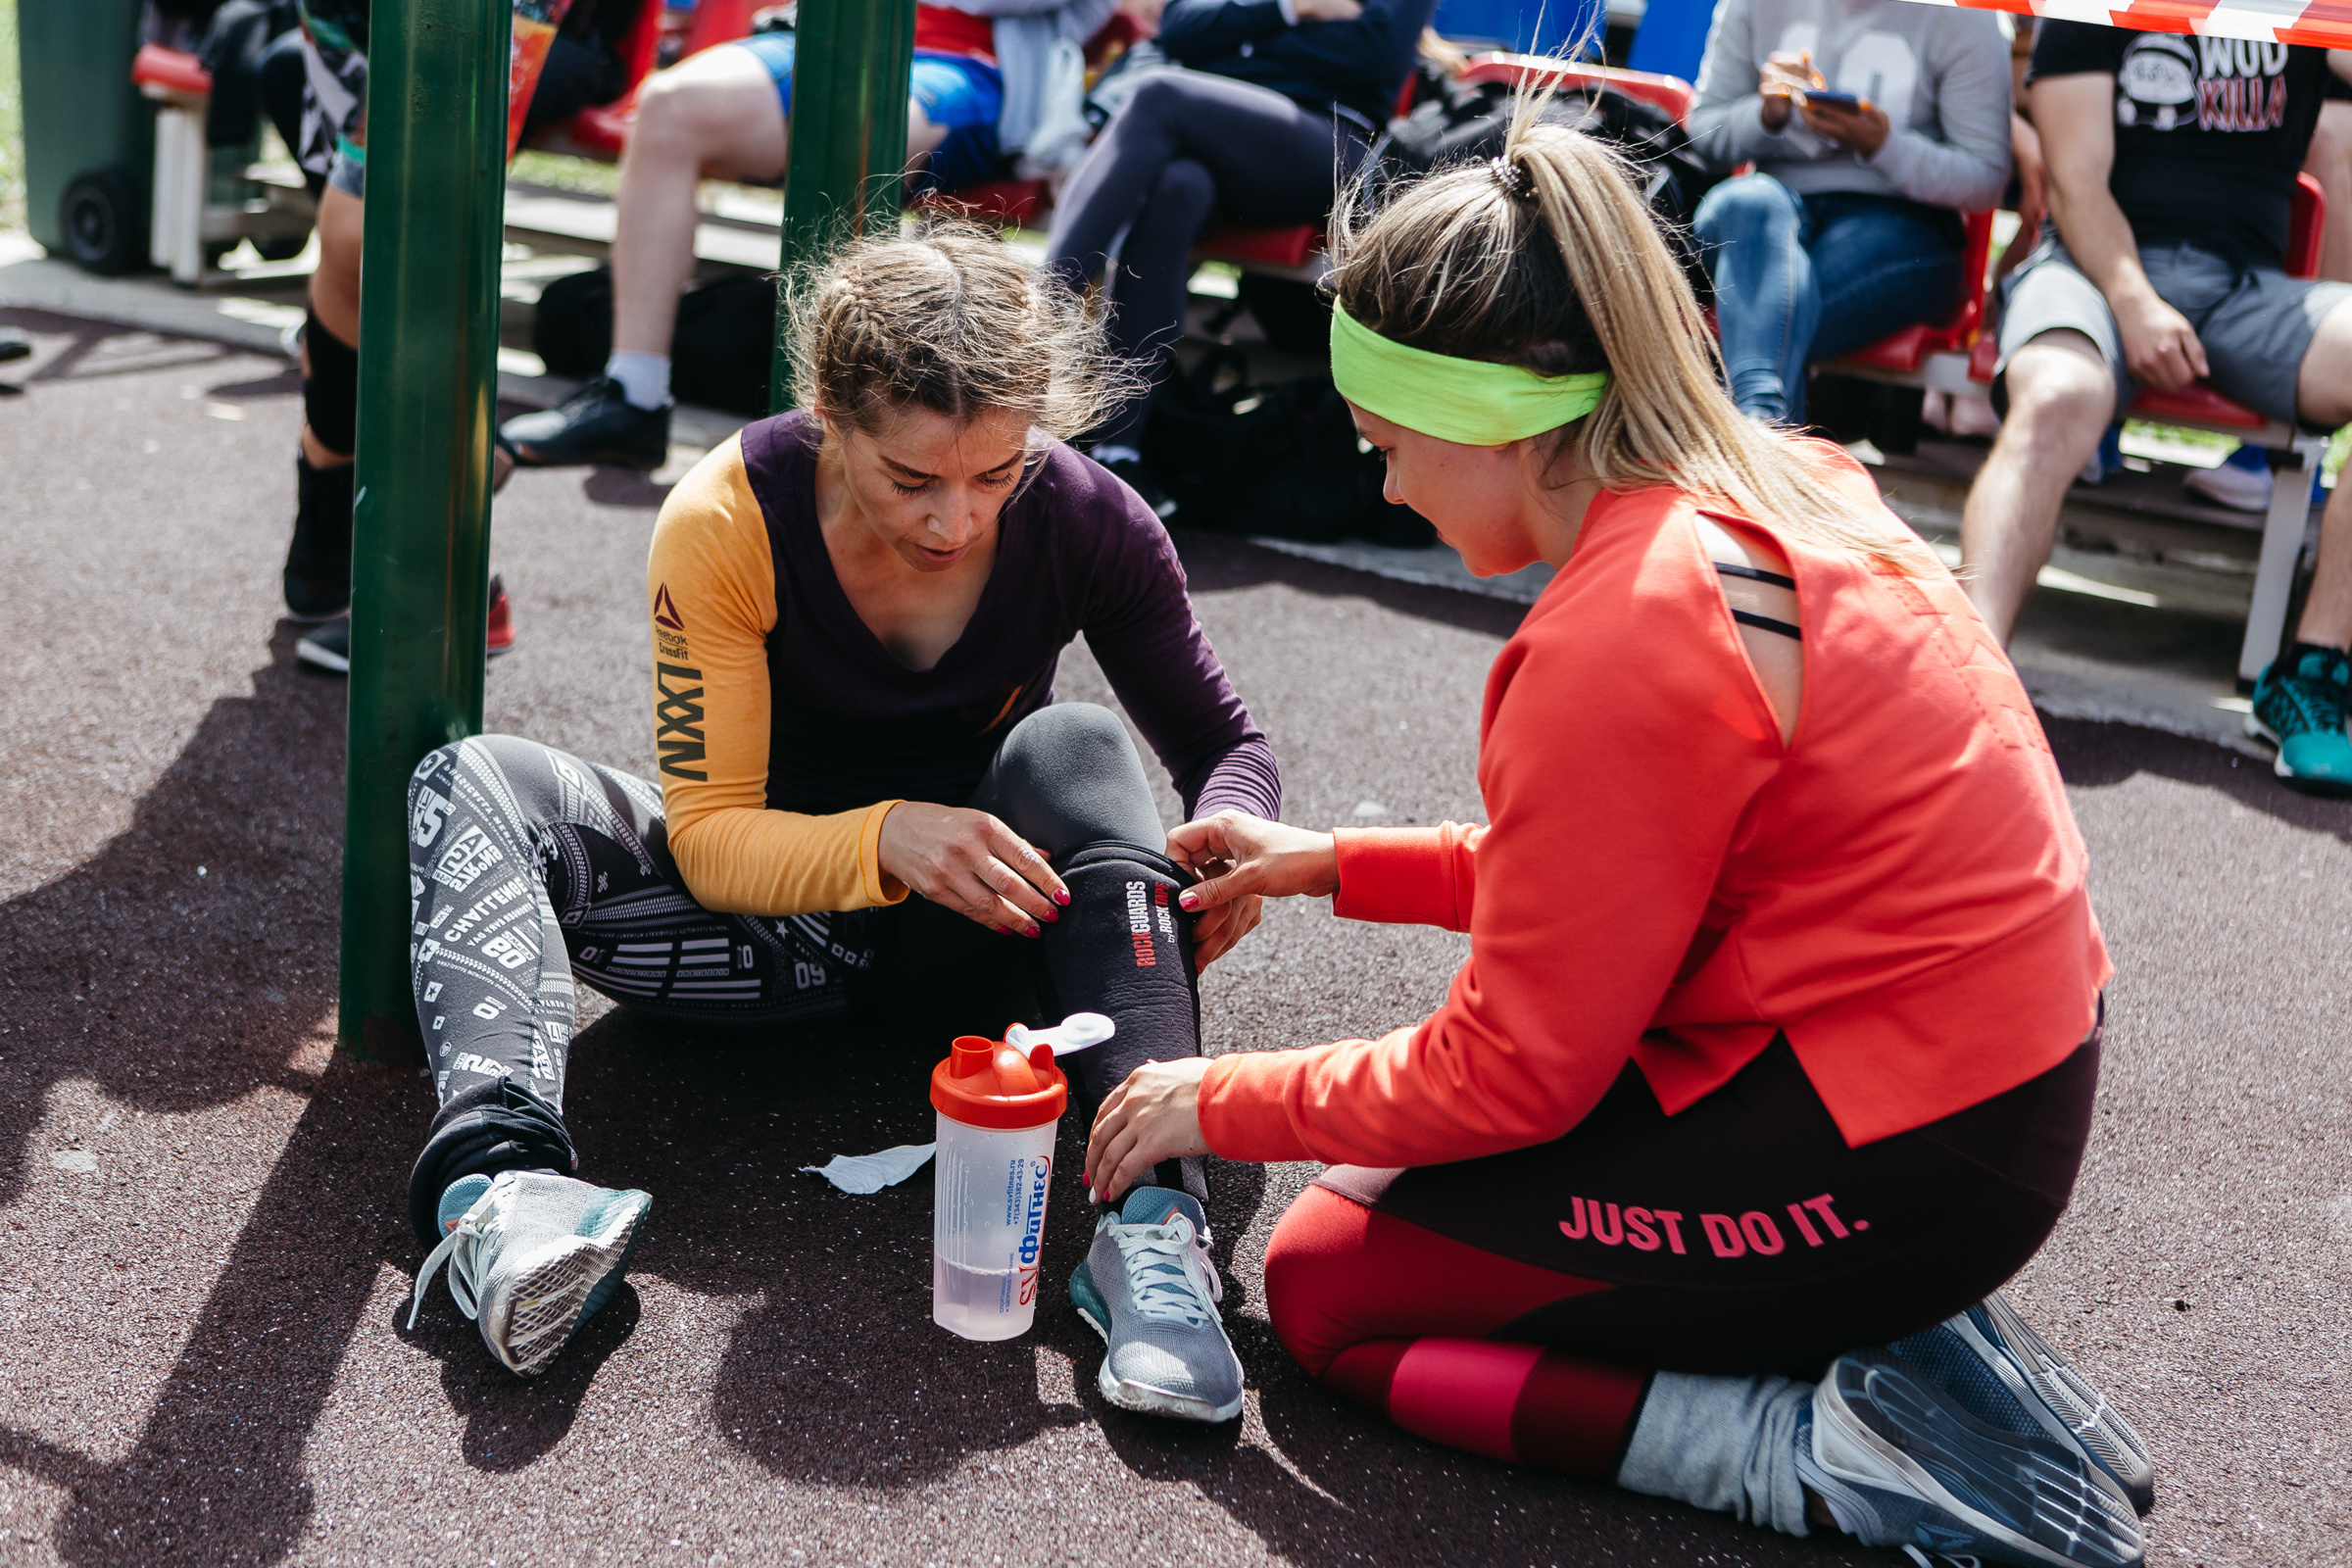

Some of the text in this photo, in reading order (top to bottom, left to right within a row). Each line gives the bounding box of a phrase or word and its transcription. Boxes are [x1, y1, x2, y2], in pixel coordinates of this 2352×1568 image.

[2198, 74, 2286, 132] KILLA
[660, 642, 689, 661] CrossFit
[1006, 1159, 1016, 1227] www.svfitnes.ru
[1013, 1158, 1024, 1225] +7(343)382-43-29
[1559, 1193, 1870, 1258] JUST DO IT.
